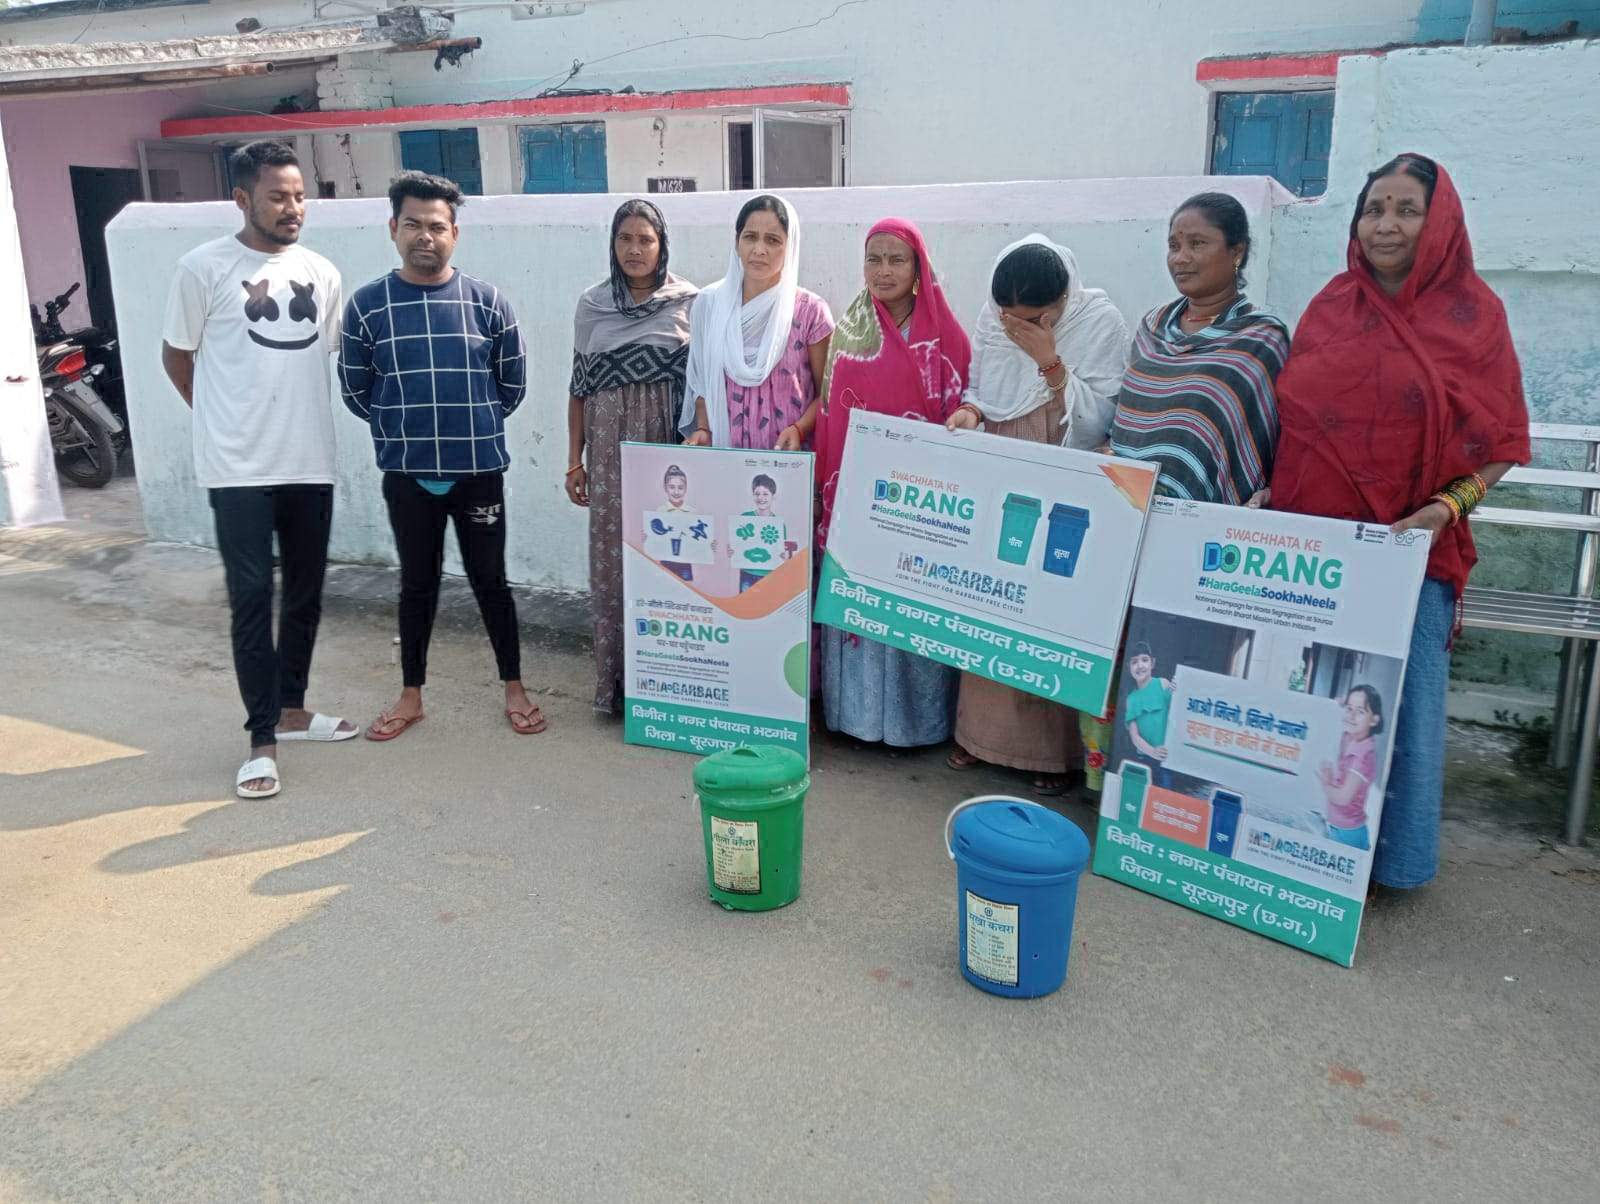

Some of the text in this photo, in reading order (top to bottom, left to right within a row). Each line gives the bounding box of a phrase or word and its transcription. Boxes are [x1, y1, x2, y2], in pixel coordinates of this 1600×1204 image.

[890, 470, 960, 493] SWACHHATA KE
[874, 479, 975, 520] DO RANG
[871, 503, 971, 535] #HaraGeelaSookhaNeela
[1225, 527, 1322, 552] SWACHHATA KE
[897, 552, 938, 578] INDIA
[949, 566, 1028, 604] GARBAGE
[1203, 542, 1343, 590] DO RANG
[1198, 576, 1337, 610] #HaraGeelaSookhaNeela
[635, 618, 729, 644] DO RANG
[830, 580, 881, 608] विनीत
[897, 603, 942, 627] नगर
[944, 614, 1012, 650] पंचायत
[1018, 638, 1095, 674] भटगांव
[843, 608, 889, 636] जिला
[910, 634, 984, 671] सूरजपुर
[988, 655, 1061, 697] (छ.ग.)
[636, 677, 667, 692] INDIA
[673, 681, 729, 702] GARBAGE
[632, 705, 667, 722] विनीत
[678, 716, 706, 728] नगर
[709, 717, 750, 735] पंचायत
[753, 726, 797, 742] भटगांव
[645, 725, 676, 742] जिला
[1106, 825, 1154, 855] विनीत
[1169, 850, 1209, 875] नगर
[1213, 863, 1275, 898] पंचायत
[1278, 886, 1346, 922] भटगांव
[1291, 842, 1356, 876] GARBAGE
[1120, 855, 1162, 885] जिला
[1182, 881, 1250, 918] सूरजपुर
[1252, 903, 1317, 944] (छ.ग.)
